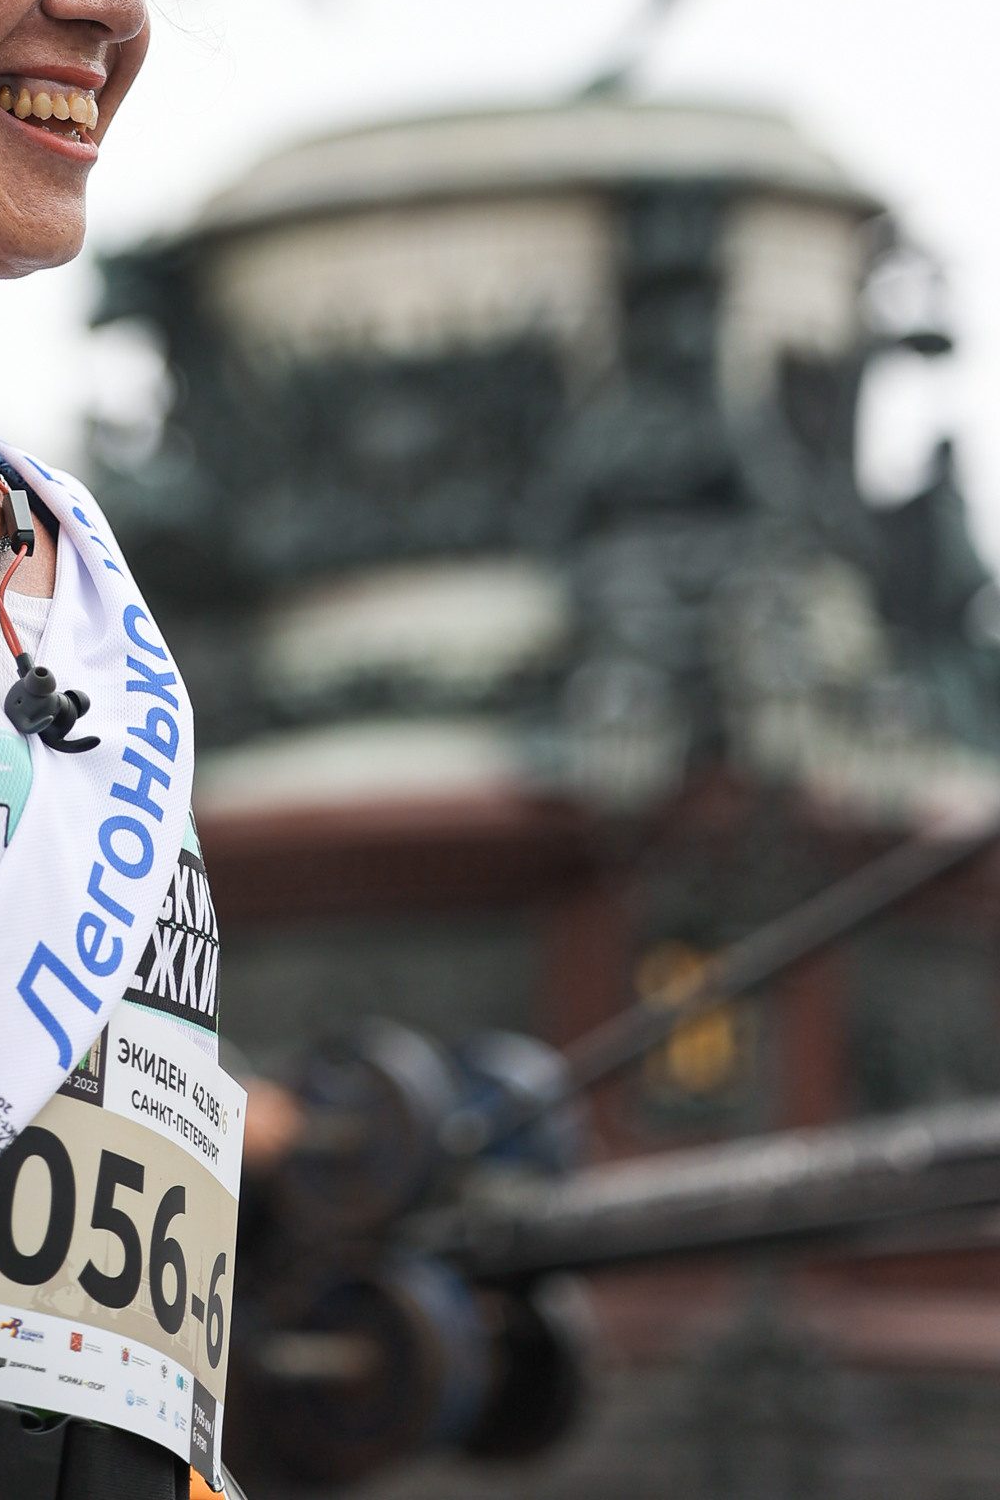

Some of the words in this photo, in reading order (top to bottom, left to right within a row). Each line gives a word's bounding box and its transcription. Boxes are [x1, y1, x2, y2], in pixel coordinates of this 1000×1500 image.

[16, 604, 181, 1071] Легонько
[132, 923, 220, 1018] ЖКИ
[73, 1075, 99, 1094] 2023
[117, 1037, 187, 1098] ЭКИДЕН
[192, 1082, 229, 1136] 42.195/6
[131, 1089, 220, 1166] САНКТ-ПЕТЕРБУРГ
